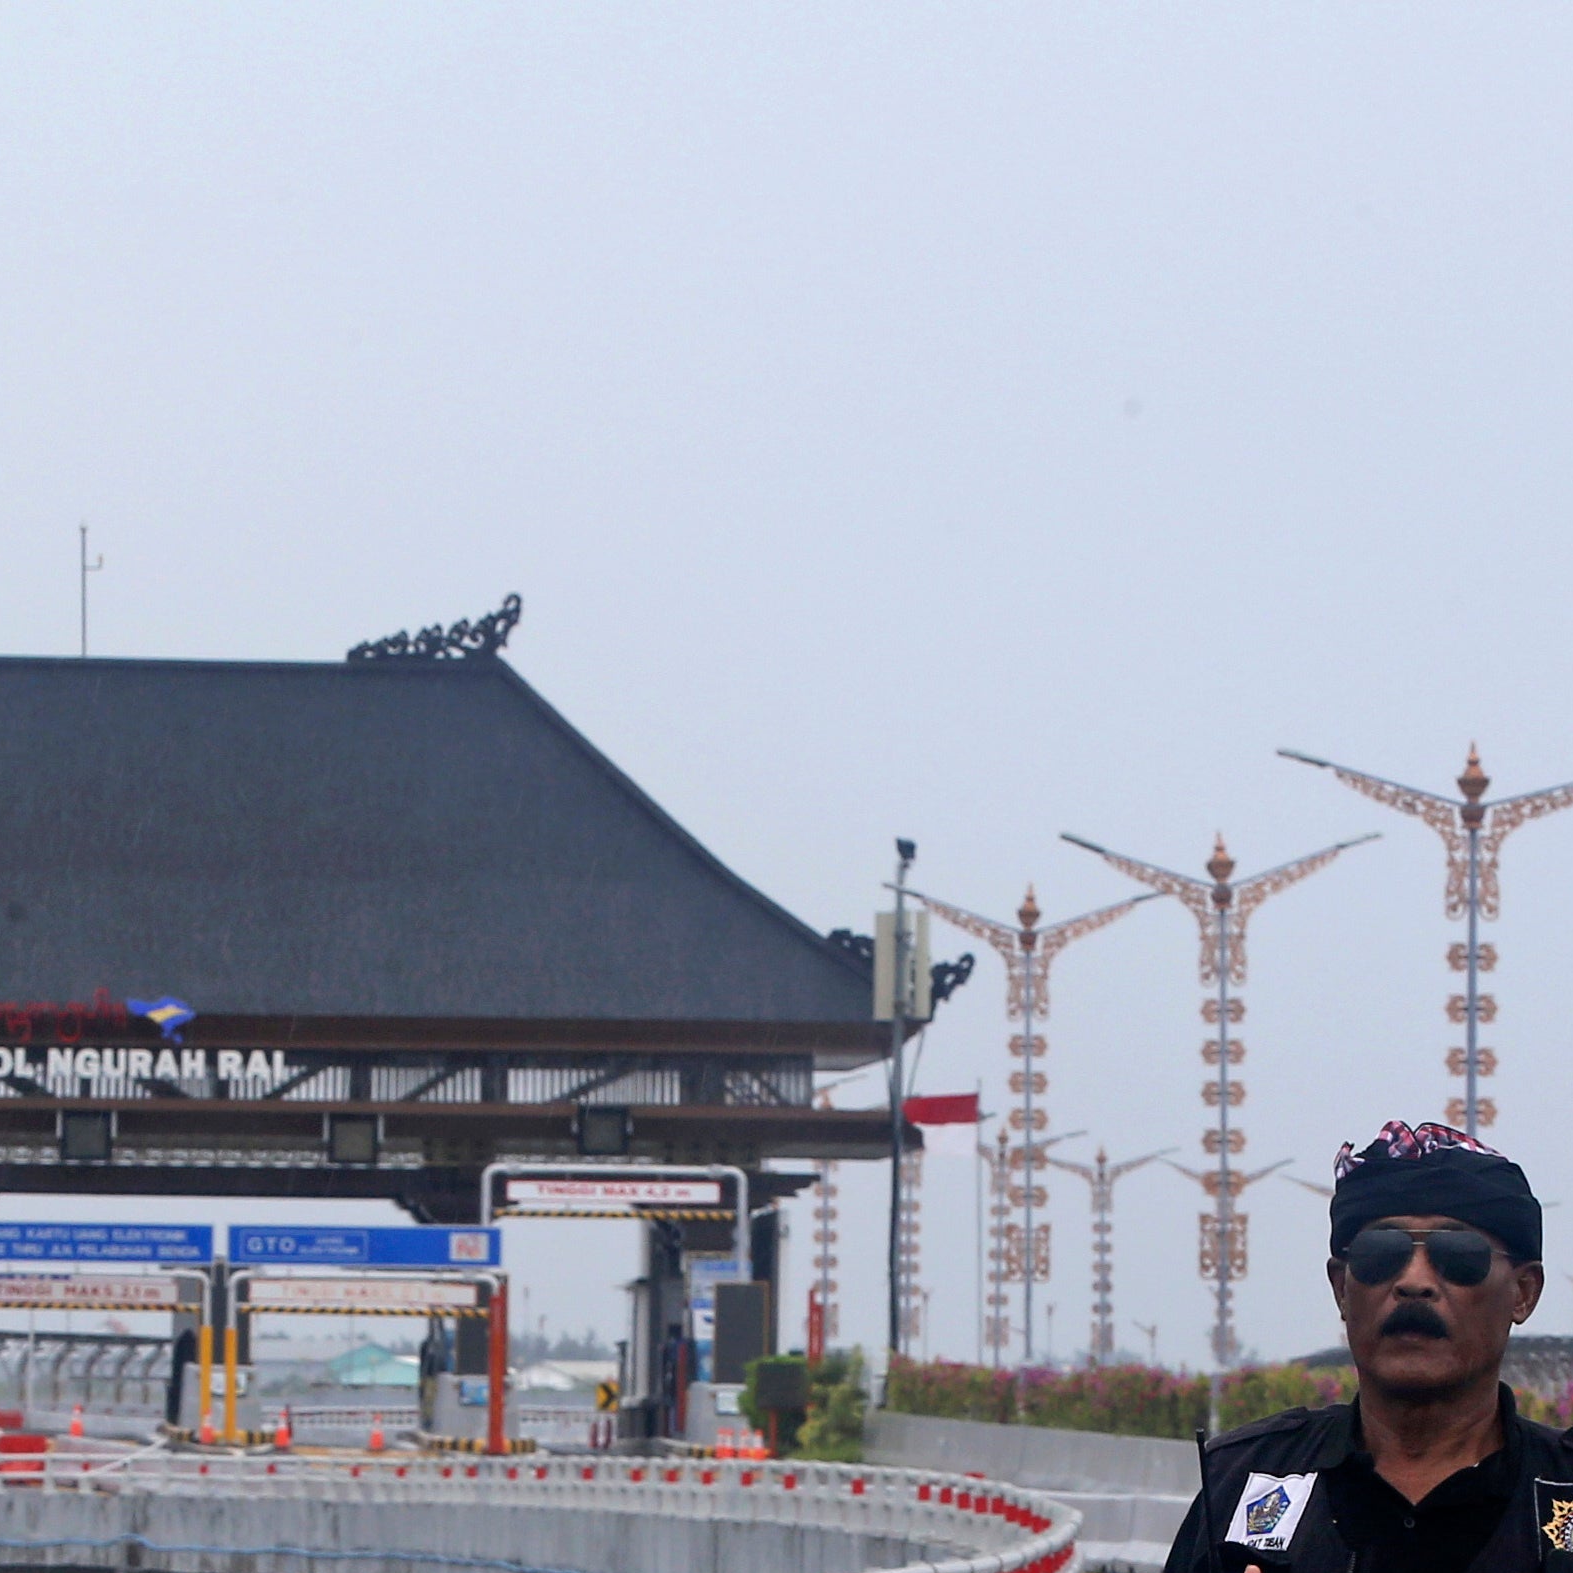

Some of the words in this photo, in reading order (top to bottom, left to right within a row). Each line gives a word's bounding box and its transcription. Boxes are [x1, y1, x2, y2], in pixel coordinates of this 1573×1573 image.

[46, 1047, 207, 1080] NGURAH
[216, 1049, 284, 1081] RAI
[247, 1236, 297, 1255] GTO
[64, 1285, 113, 1298] MAKS
